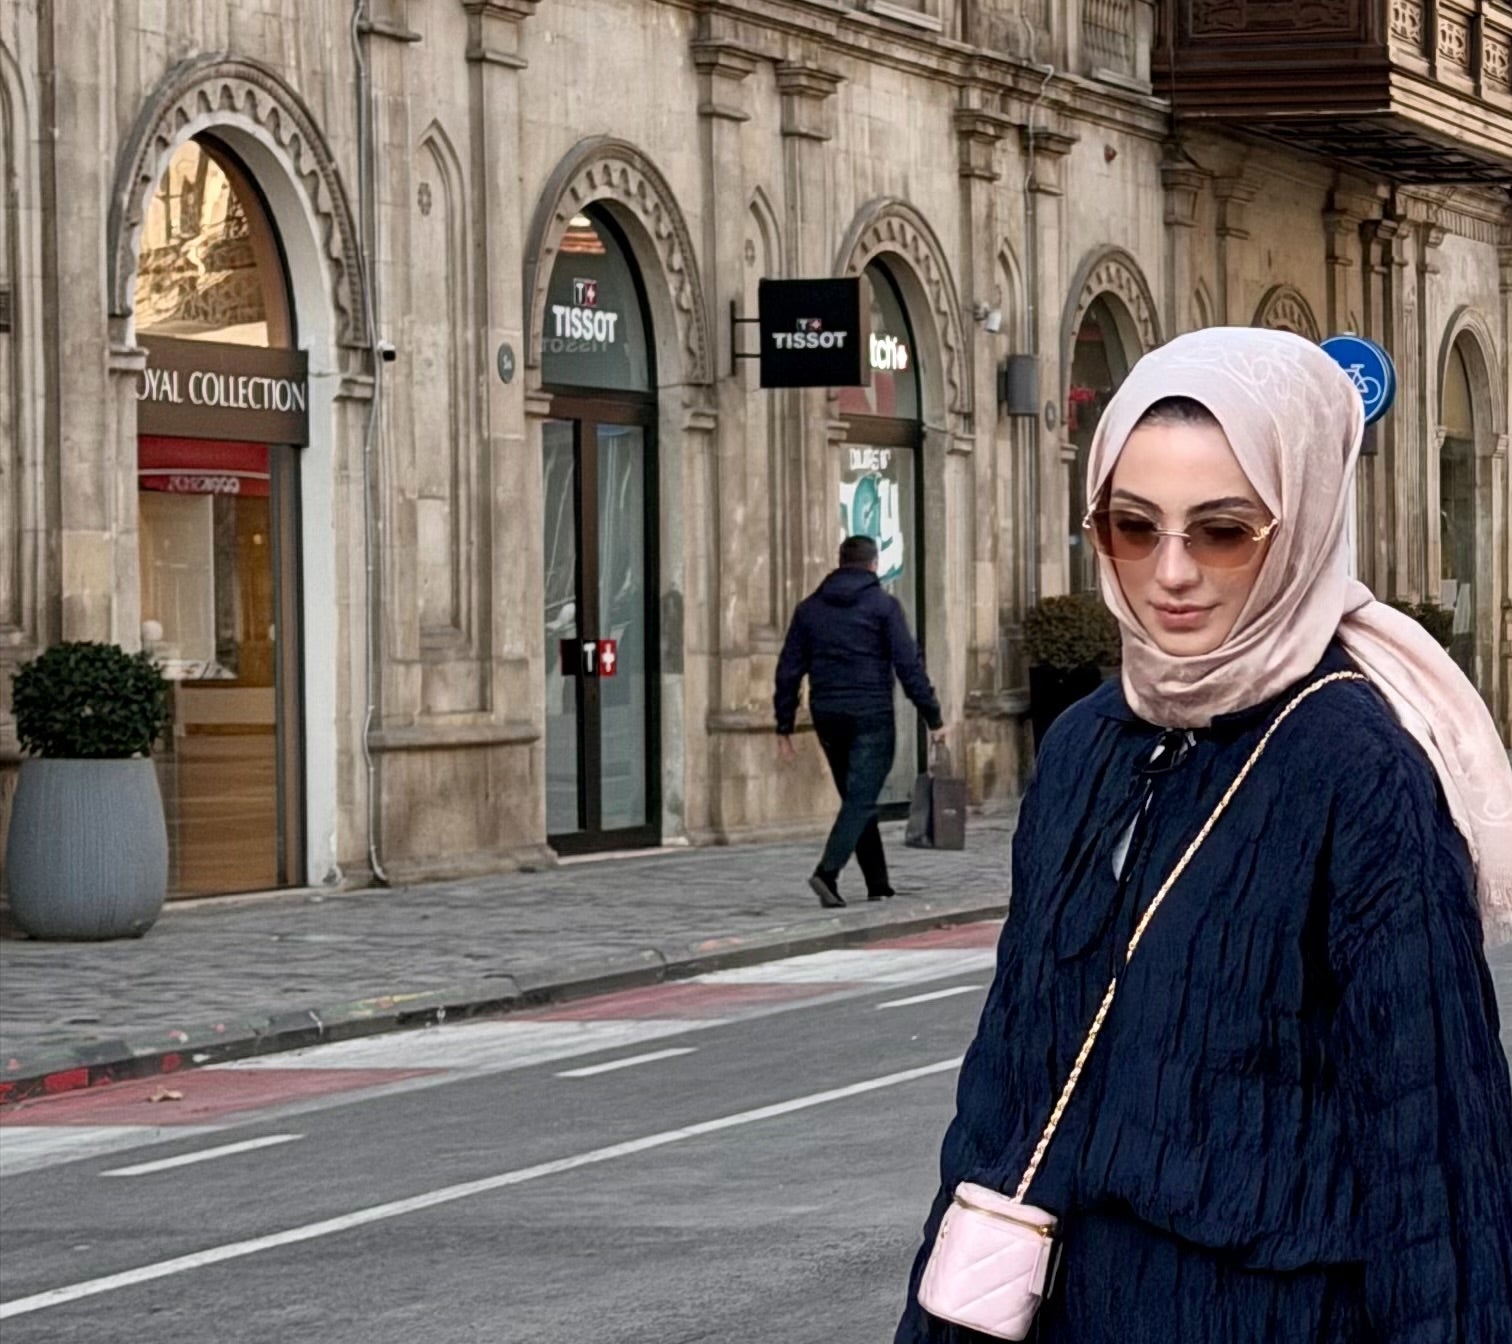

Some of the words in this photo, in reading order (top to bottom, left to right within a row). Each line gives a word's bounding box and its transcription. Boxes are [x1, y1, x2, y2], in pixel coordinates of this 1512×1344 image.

[552, 304, 618, 343] TISSOT
[772, 331, 848, 349] TISSOT
[869, 332, 897, 370] tch
[135, 367, 183, 404] OYAL
[188, 370, 306, 413] COLLECTION
